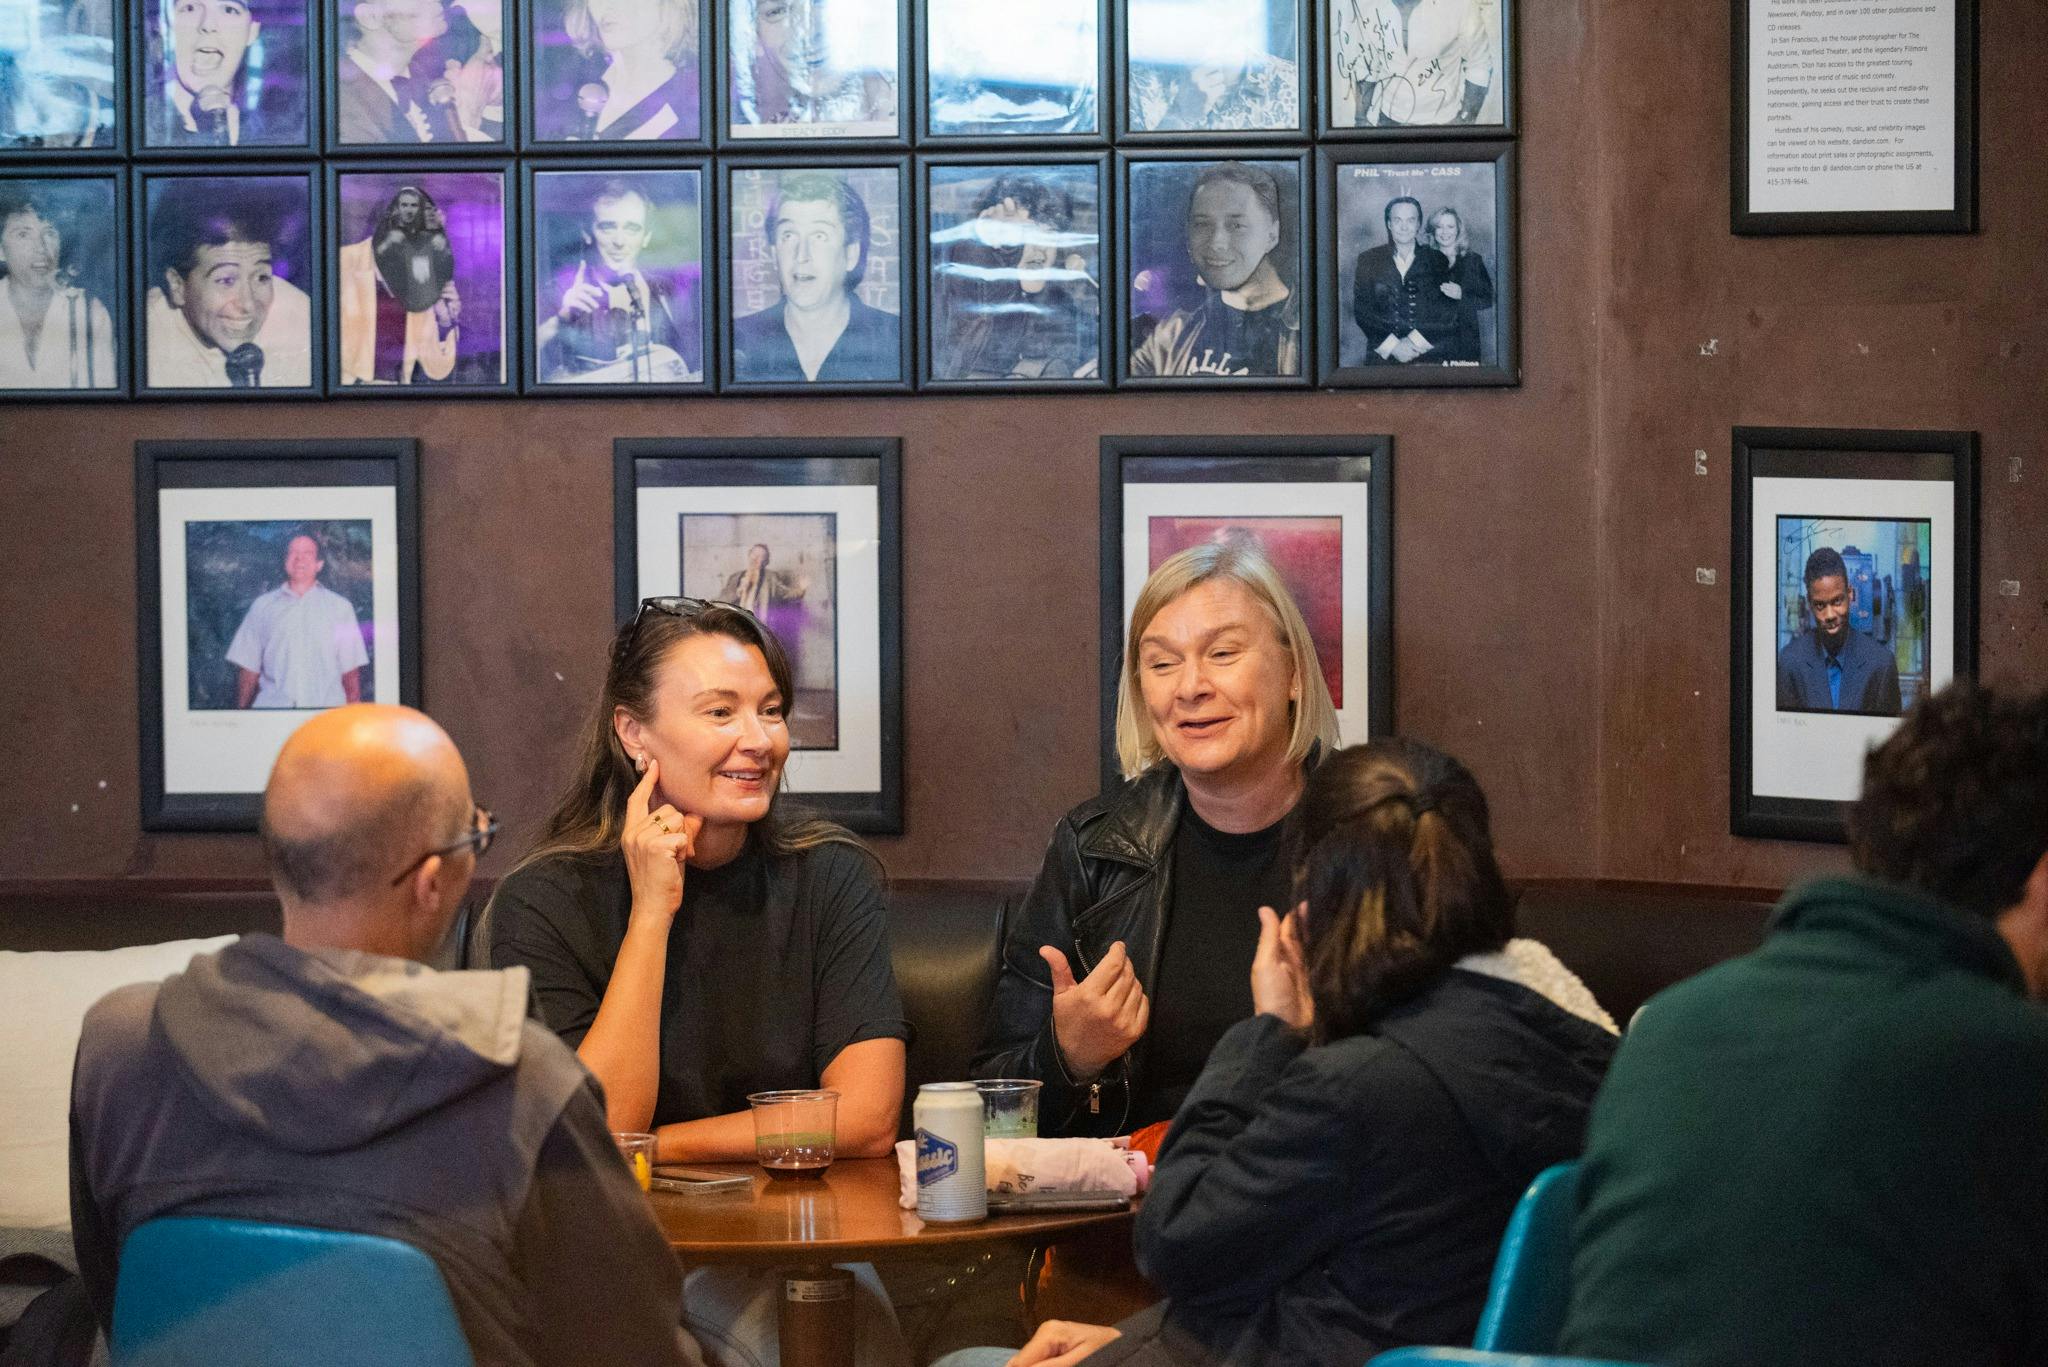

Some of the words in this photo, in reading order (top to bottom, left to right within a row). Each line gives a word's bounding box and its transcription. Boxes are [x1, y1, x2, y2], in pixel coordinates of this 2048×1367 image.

[1353, 168, 1380, 178] PHIL
[1383, 169, 1410, 177] "Trust
[1431, 167, 1461, 177] CASS
